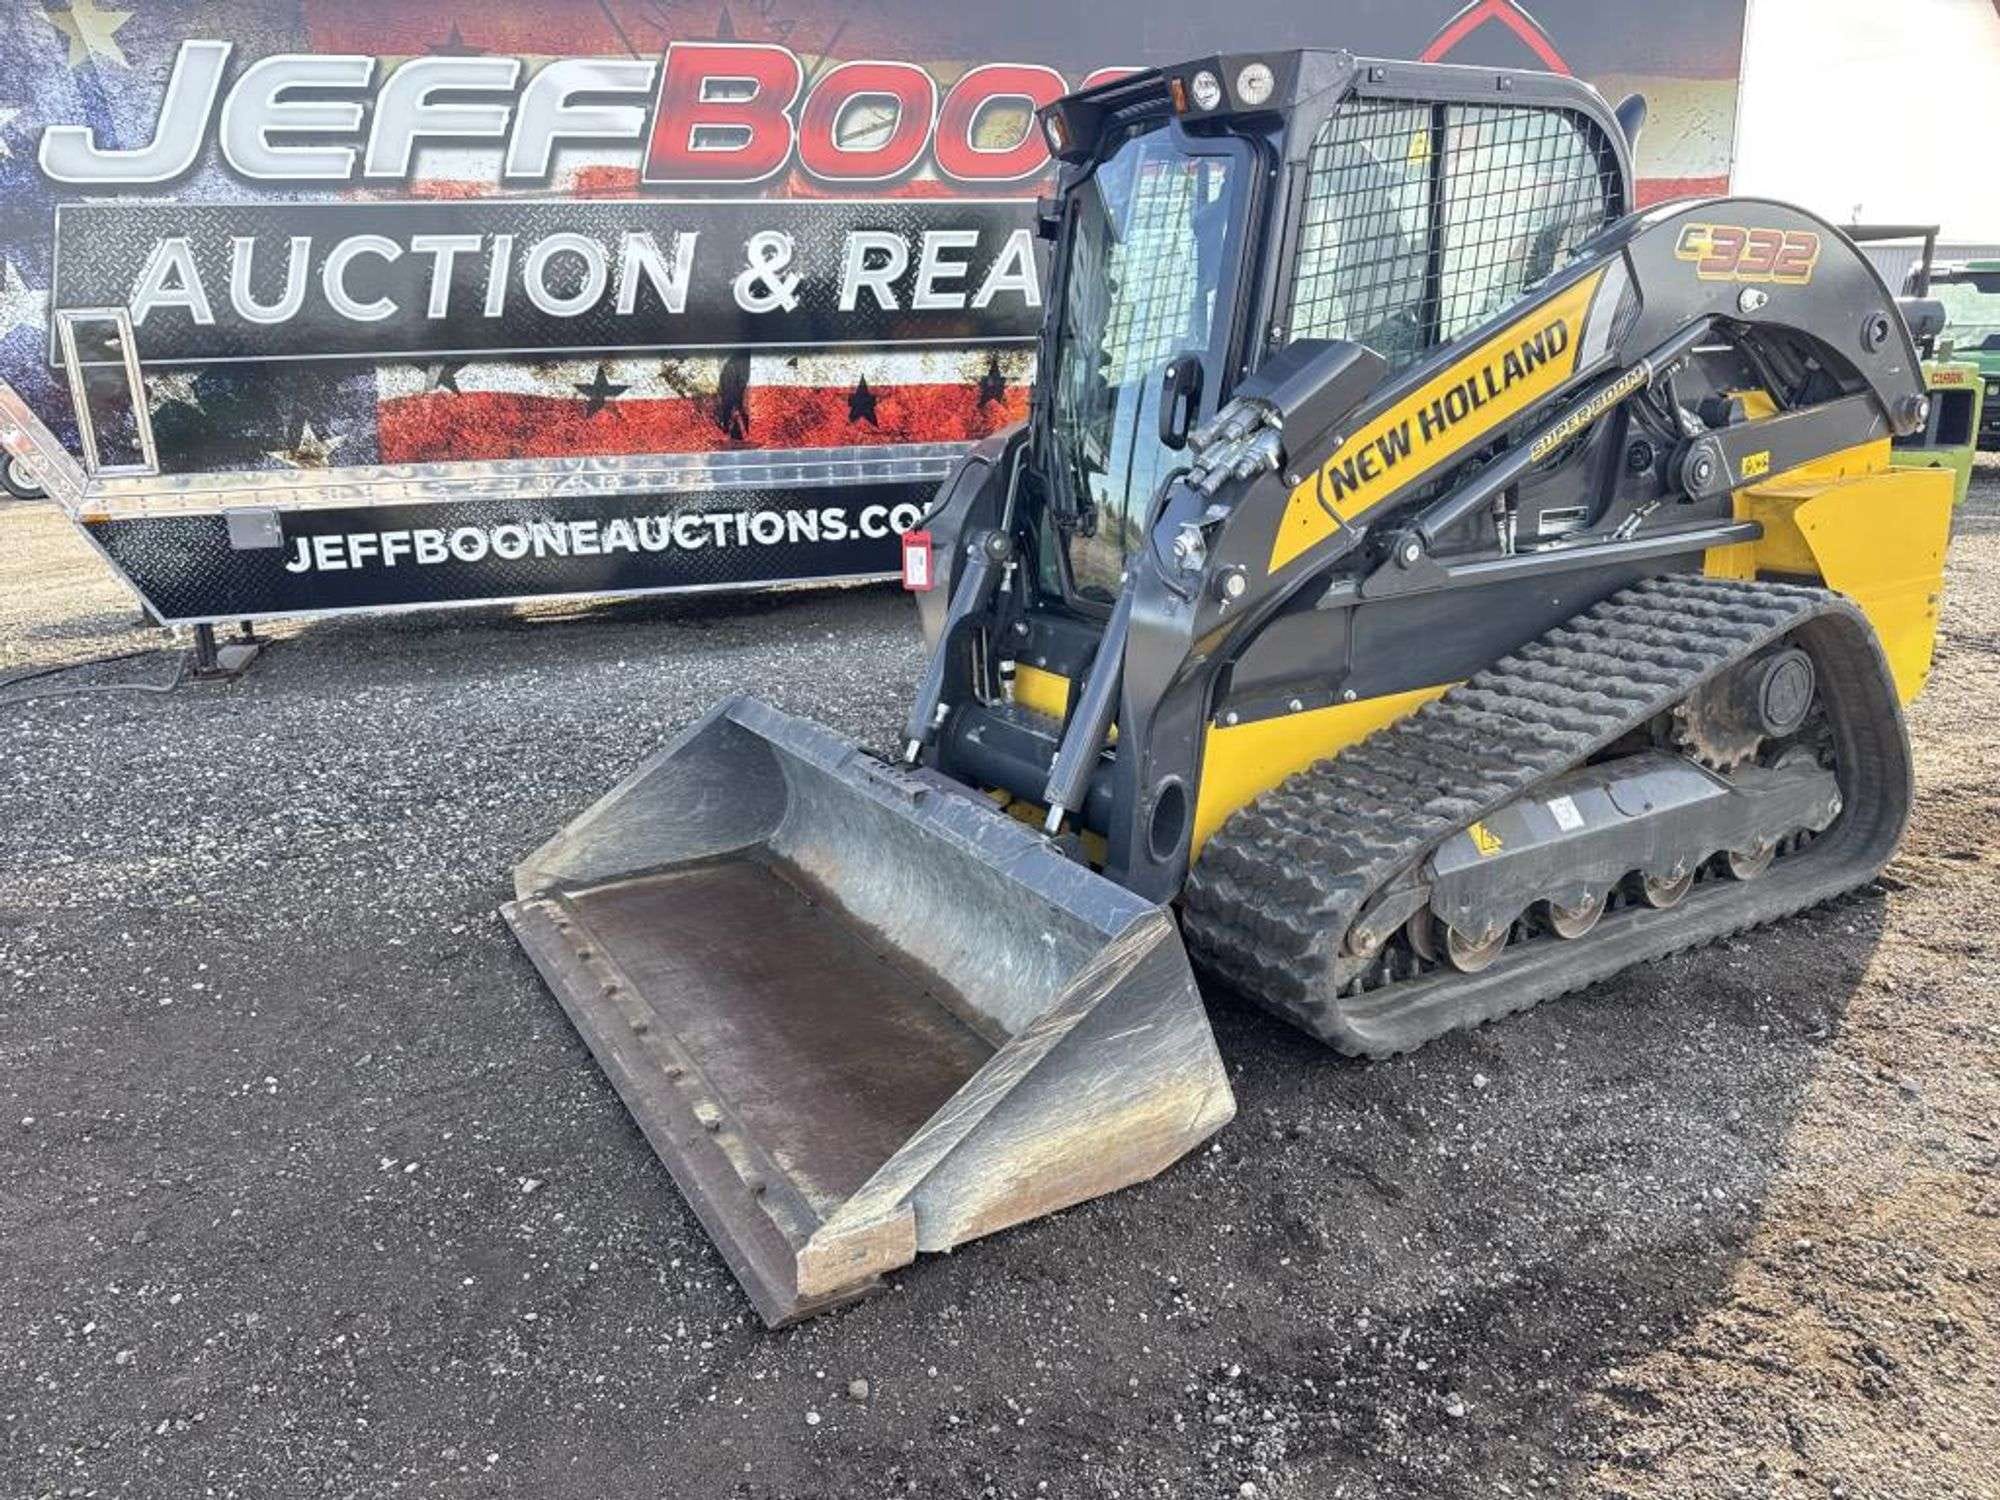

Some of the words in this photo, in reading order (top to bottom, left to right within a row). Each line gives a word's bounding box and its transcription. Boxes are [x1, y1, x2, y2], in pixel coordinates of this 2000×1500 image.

[38, 40, 1150, 184] JEFFBOO
[130, 232, 697, 326] AUCTION
[733, 229, 804, 315] &
[838, 228, 1042, 312] REA
[1328, 420, 1412, 502] NEW
[1417, 318, 1568, 445] HOLLAND
